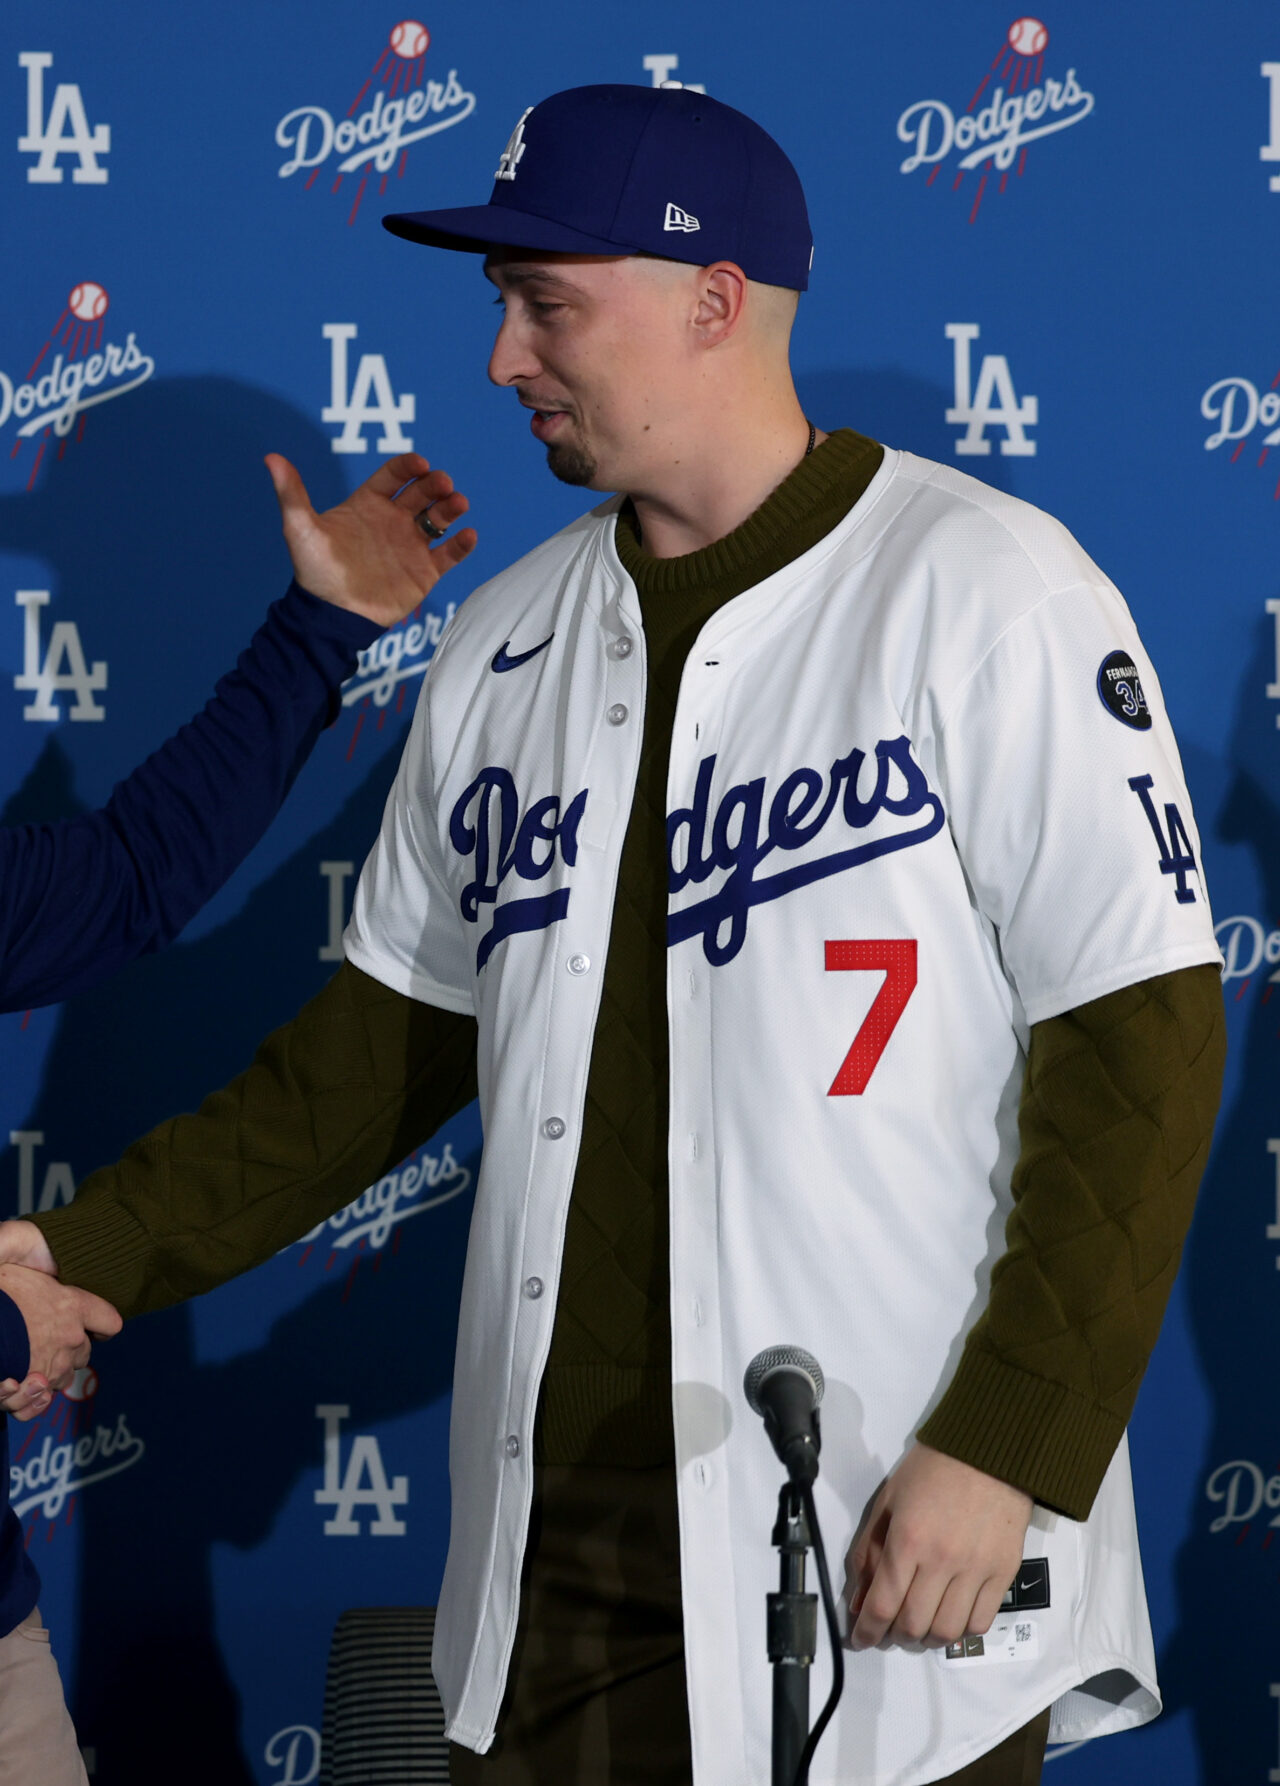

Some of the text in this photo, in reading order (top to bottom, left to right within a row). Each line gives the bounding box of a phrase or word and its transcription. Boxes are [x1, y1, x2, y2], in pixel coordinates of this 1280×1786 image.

[17, 51, 111, 184] LA
[275, 69, 477, 178] Dodgers
[896, 68, 1095, 174] Dodgers
[321, 323, 416, 454] LA
[944, 322, 1039, 456] LA
[14, 589, 108, 721] LA
[1128, 773, 1197, 904] LA
[824, 939, 918, 1097] 7
[9, 1413, 146, 1519] odgers
[314, 1405, 409, 1537] LA
